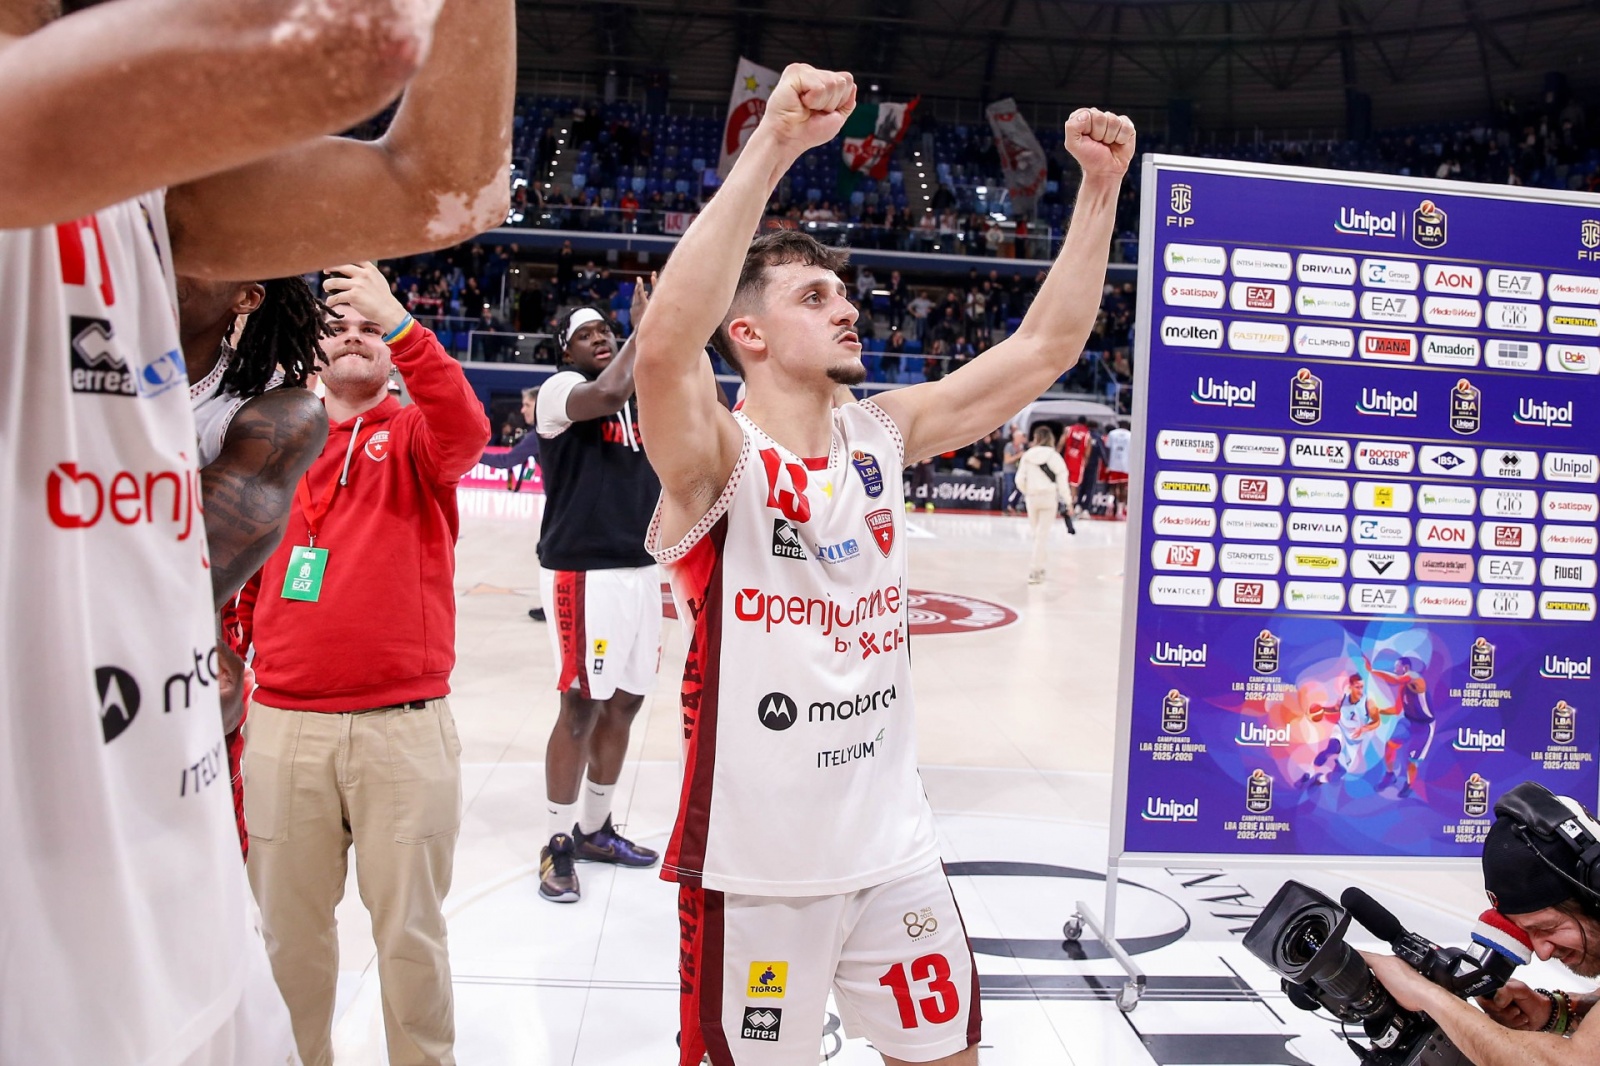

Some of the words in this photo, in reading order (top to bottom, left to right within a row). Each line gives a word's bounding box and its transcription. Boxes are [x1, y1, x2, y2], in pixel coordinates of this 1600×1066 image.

[1166, 216, 1194, 228] FIP
[1340, 206, 1396, 236] Unipol
[1418, 225, 1442, 237] LBA
[1186, 256, 1220, 265] plenitude
[1302, 264, 1352, 276] DRIVALIA
[1388, 271, 1410, 280] Group
[1435, 271, 1472, 288] AON
[1498, 274, 1532, 290] EA7
[1180, 288, 1218, 298] satispay
[1248, 288, 1272, 300] EA7
[1317, 298, 1350, 307] plenitude
[1372, 296, 1406, 313] EA7
[1553, 316, 1598, 327] SIMMENTHAL
[1165, 326, 1218, 340] molten
[1234, 332, 1284, 342] FASTWEB
[1368, 338, 1408, 352] UMANA
[1428, 342, 1475, 356] Amadori
[1564, 352, 1586, 362] Dole
[72, 368, 136, 393] errea
[1198, 376, 1256, 408] Unipol
[1295, 390, 1318, 401] LBA
[1362, 388, 1418, 417] Unipol
[1454, 400, 1477, 411] LBA
[1296, 409, 1316, 420] Unipol
[1520, 398, 1573, 428] Unipol
[1455, 419, 1474, 429] Unipol
[1170, 438, 1214, 449] POKERSTARS
[1296, 444, 1344, 458] PALLEX
[1369, 449, 1408, 459] DOCTOR
[1368, 458, 1400, 466] GLASS
[1438, 456, 1459, 466] IBSA
[861, 466, 879, 478] LBA
[1553, 457, 1592, 478] Unipol
[1161, 482, 1212, 492] SIMMENTHAL
[1240, 480, 1266, 492] EA7
[952, 482, 995, 502] World
[1310, 490, 1344, 498] plenitude
[1438, 496, 1470, 504] plenitude
[1558, 502, 1592, 512] satispay
[870, 514, 891, 526] VARESE
[1292, 522, 1342, 533] DRIVALIA
[1380, 526, 1402, 534] Group
[1496, 528, 1520, 538] EA7
[1427, 525, 1465, 542] AON
[774, 543, 806, 558] errea
[1171, 546, 1194, 562] RDS
[1227, 552, 1274, 561] STARHOTELS
[1490, 561, 1524, 576] EA7
[1554, 566, 1582, 580] FIUGGI
[292, 580, 312, 590] EA7
[1236, 584, 1262, 596] EA7
[1158, 587, 1206, 595] VIVATICKET
[1362, 589, 1397, 604] EA7
[1306, 593, 1340, 601] plenitude
[1545, 601, 1590, 611] SIMMENTHAL
[1156, 641, 1207, 667] Unipol
[1258, 646, 1276, 655] LBA
[1545, 655, 1591, 680] Unipol
[1232, 682, 1244, 692] LBA
[1246, 682, 1265, 692] SERIE
[1267, 682, 1272, 692] A
[1273, 682, 1297, 692] UNIPOL
[1244, 692, 1284, 701] 2025/2026
[1450, 689, 1461, 699] LBA
[1463, 689, 1481, 699] SERIE
[1482, 689, 1487, 699] A
[1489, 689, 1512, 699] UNIPOL
[1462, 699, 1499, 708] 2025/2026
[1166, 707, 1184, 715] LBA
[1240, 722, 1291, 747] Unipol
[1458, 728, 1505, 752] Unipol
[1140, 742, 1152, 752] LBA
[1154, 742, 1173, 752] SERIE
[1175, 742, 1180, 752] A
[1182, 742, 1206, 752] UNIPOL
[817, 742, 875, 768] ITELYUM
[1152, 752, 1193, 761] 2025/2026
[1531, 752, 1543, 761] LBA
[1545, 752, 1562, 761] SERIE
[1563, 752, 1568, 761] A
[1570, 752, 1592, 761] UNIPOL
[1543, 761, 1580, 770] 2025/2026
[1148, 797, 1198, 822] Unipol
[1224, 822, 1236, 832] LBA
[1238, 822, 1257, 832] SERIE
[1259, 822, 1264, 832] A
[1266, 822, 1290, 832] UNIPOL
[1443, 825, 1455, 834] LBA
[1457, 825, 1474, 834] SERIE
[1476, 825, 1481, 834] A
[1236, 831, 1276, 839] 2025/2026
[1455, 834, 1486, 843] 2025/20
[750, 985, 782, 993] TIGROS
[880, 953, 960, 1030] 13
[744, 1026, 777, 1040] errea
